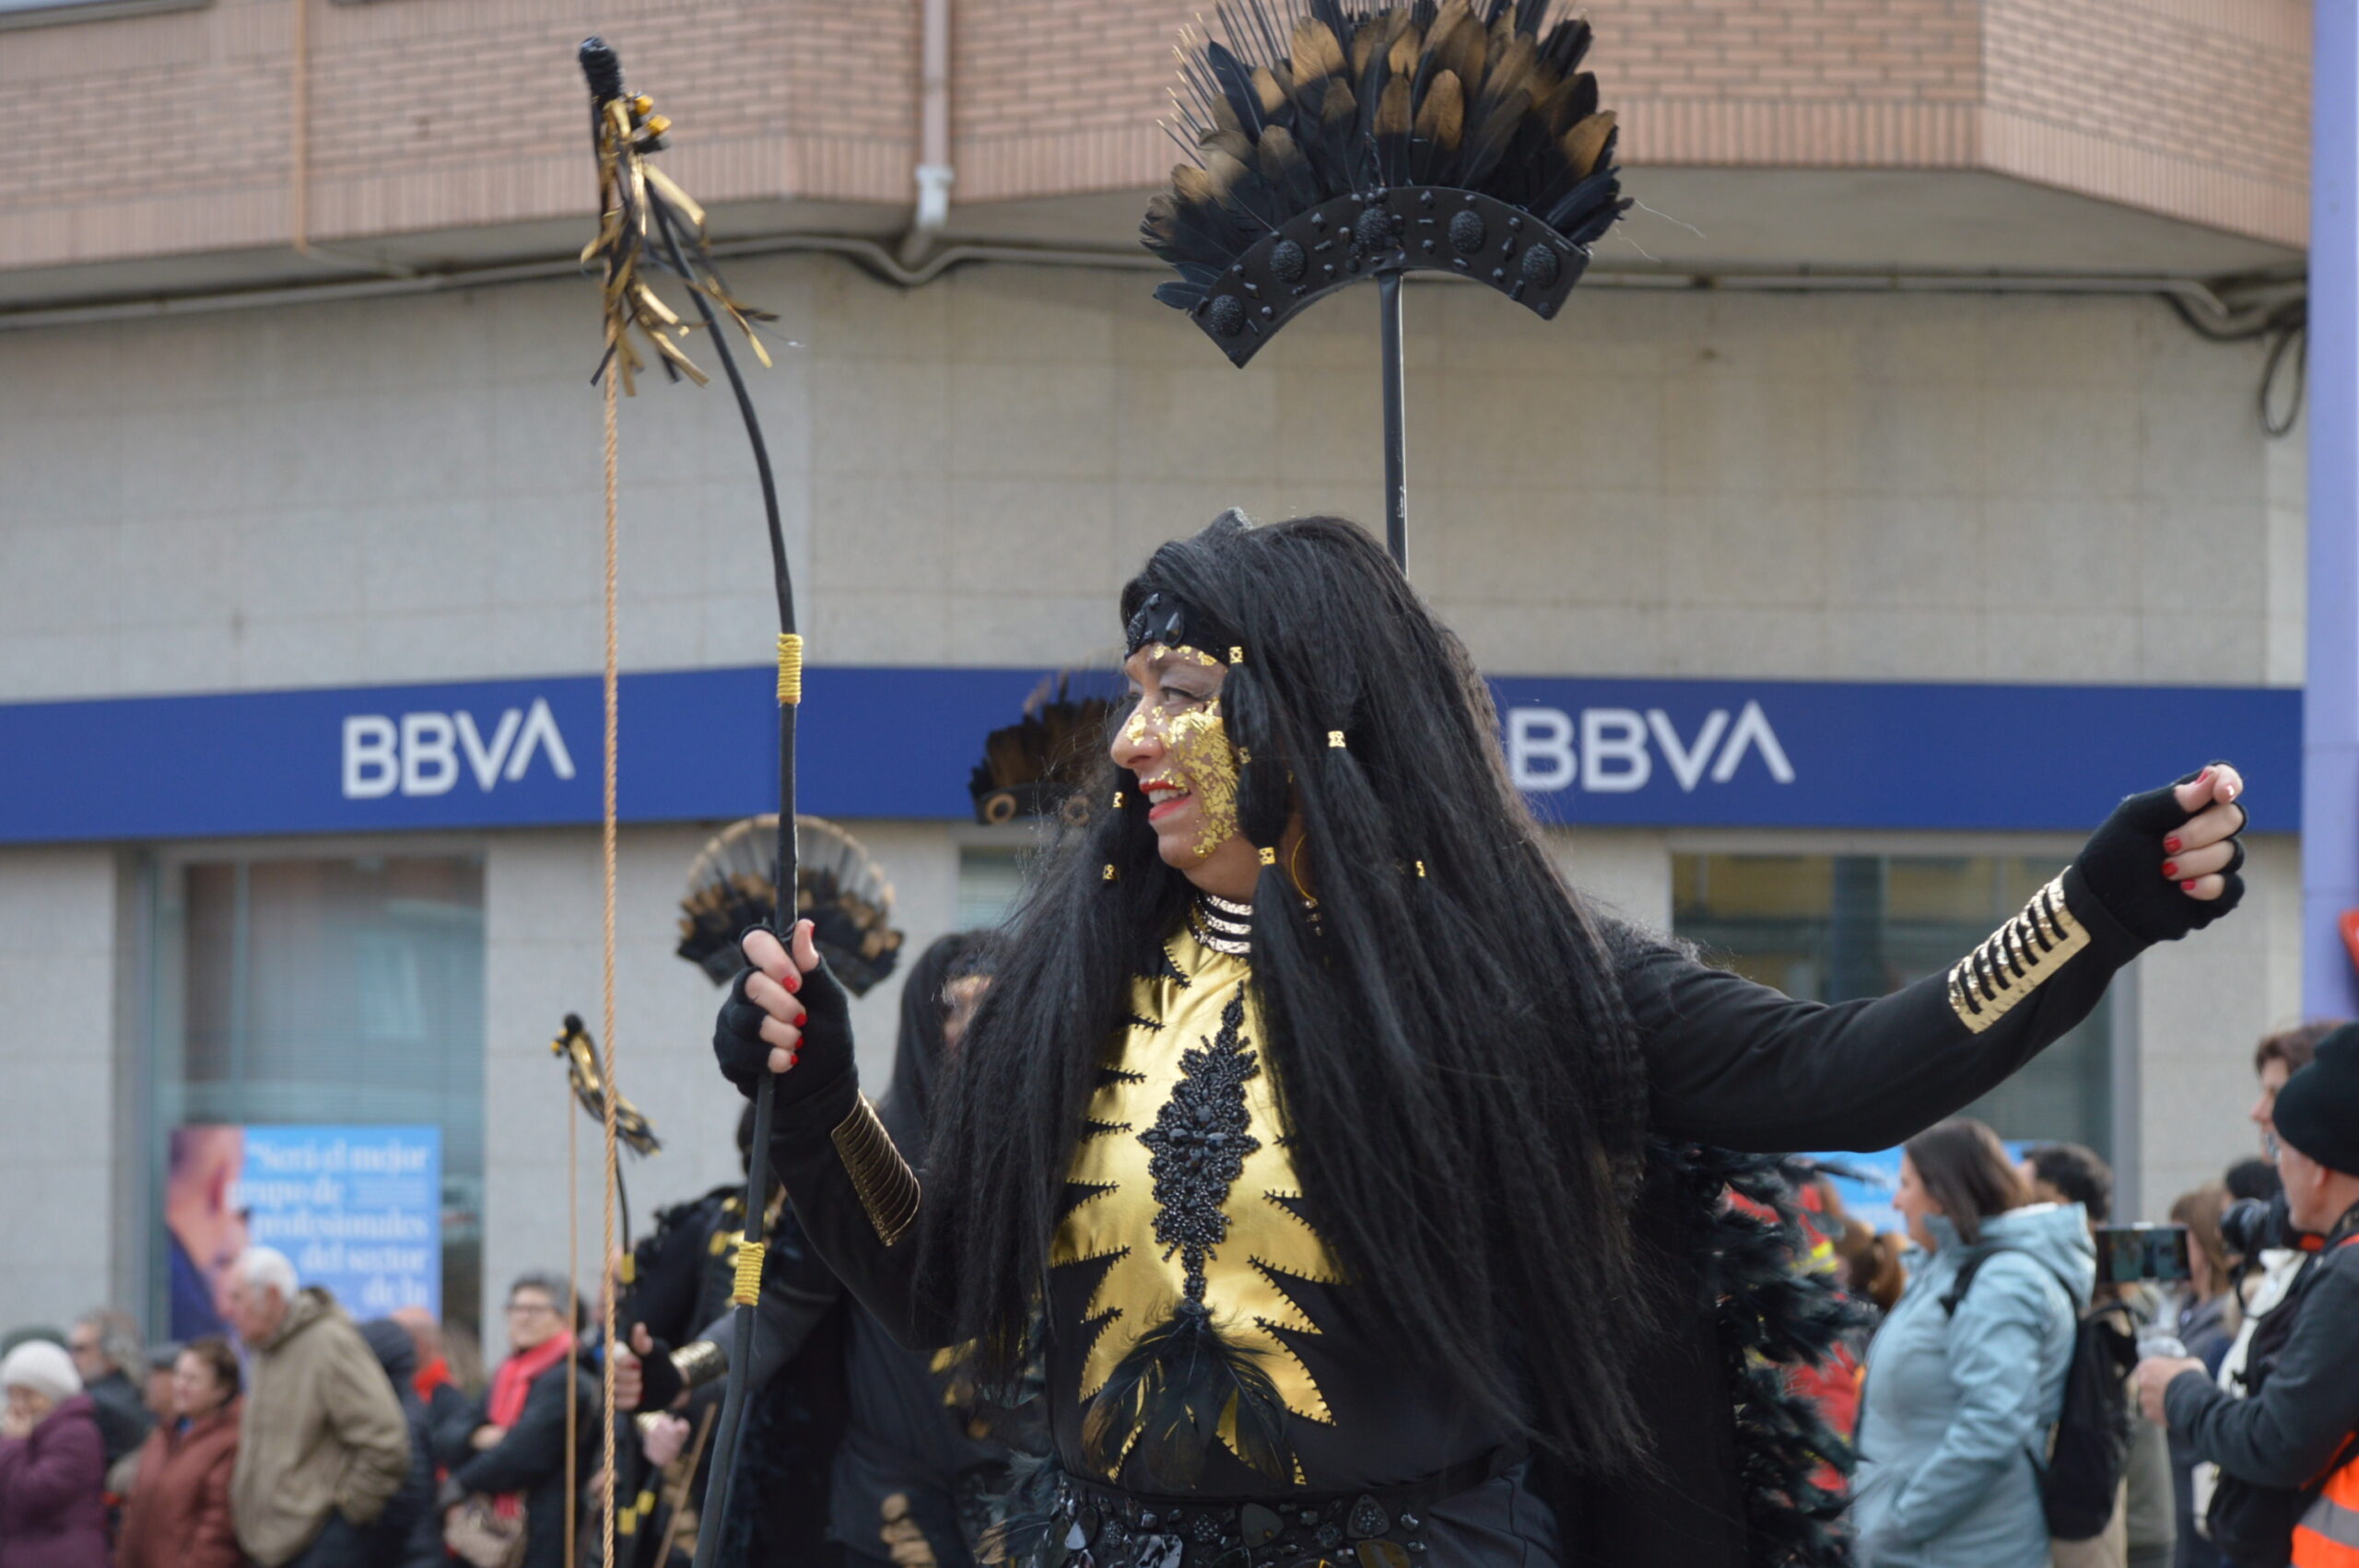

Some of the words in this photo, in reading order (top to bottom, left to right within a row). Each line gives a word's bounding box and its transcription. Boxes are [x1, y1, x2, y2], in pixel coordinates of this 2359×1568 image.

[342, 696, 576, 799] BBVA
[1508, 698, 1796, 792] BBVA
[350, 1140, 428, 1176] mejor
